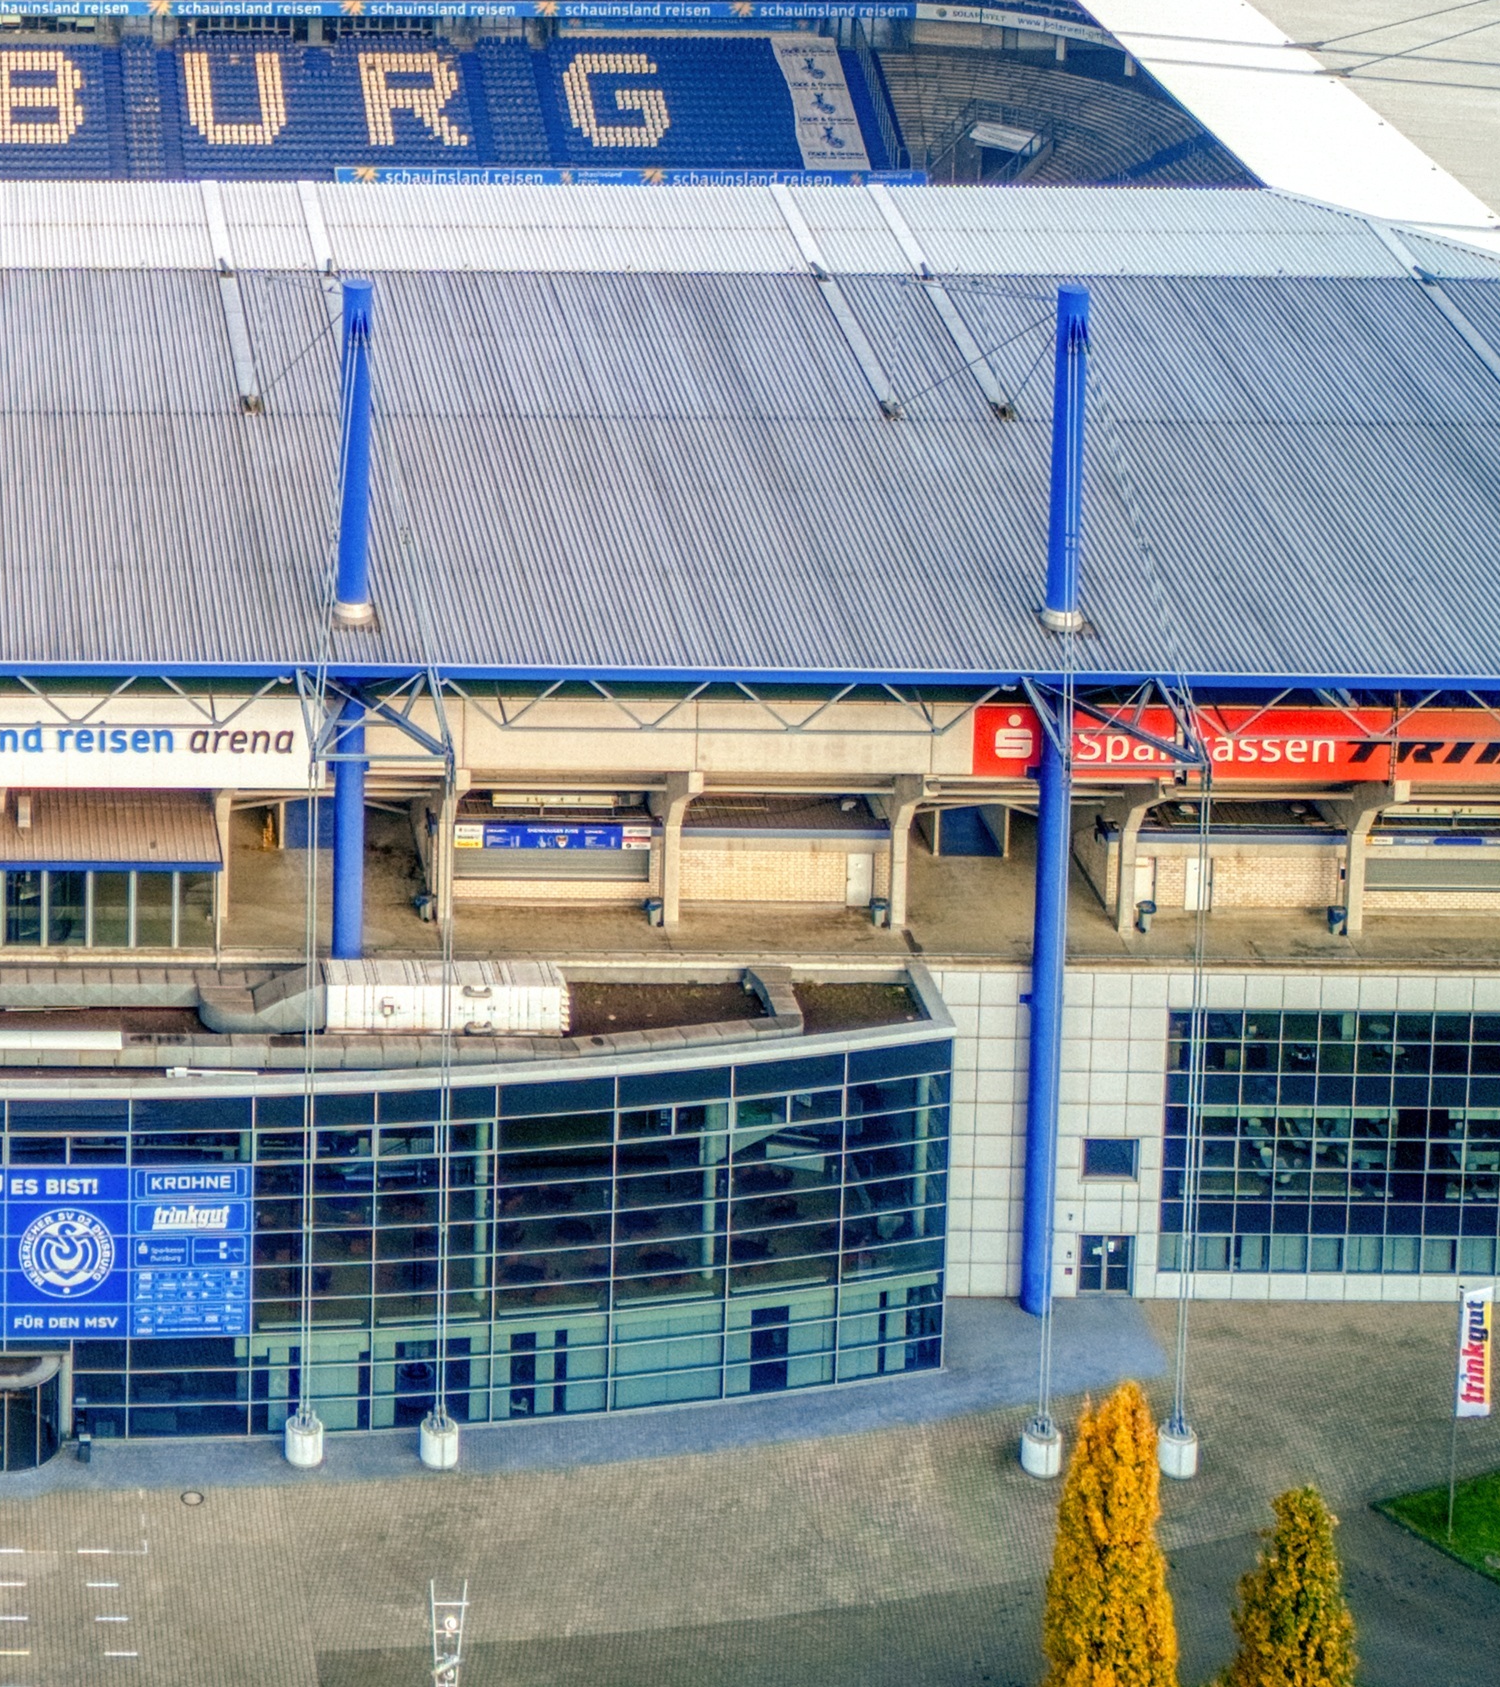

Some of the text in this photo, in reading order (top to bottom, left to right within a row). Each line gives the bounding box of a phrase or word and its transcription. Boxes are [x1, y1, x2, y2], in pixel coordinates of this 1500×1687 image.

[85, 0, 129, 15] reisen
[177, 1, 322, 16] schauinsland reisen
[371, 2, 516, 16] schauinsland reisen
[565, 3, 711, 17] schauinsland reisen
[760, 3, 908, 18] schauinsland reisen
[386, 169, 543, 184] schauinsland reisen
[673, 171, 833, 186] schauinsland reisen
[57, 721, 174, 754] reisen
[189, 728, 294, 754] arena
[10, 1178, 39, 1195] ES
[46, 1178, 98, 1195] BIST!
[151, 1175, 232, 1190] KROHNE
[153, 1204, 230, 1228] trinkgut
[21, 1212, 111, 1288] MEIDERICHER SV 02 DUISBURG
[13, 1314, 119, 1329] FÜR DEN MSV
[1460, 1300, 1490, 1405] trinkgut
